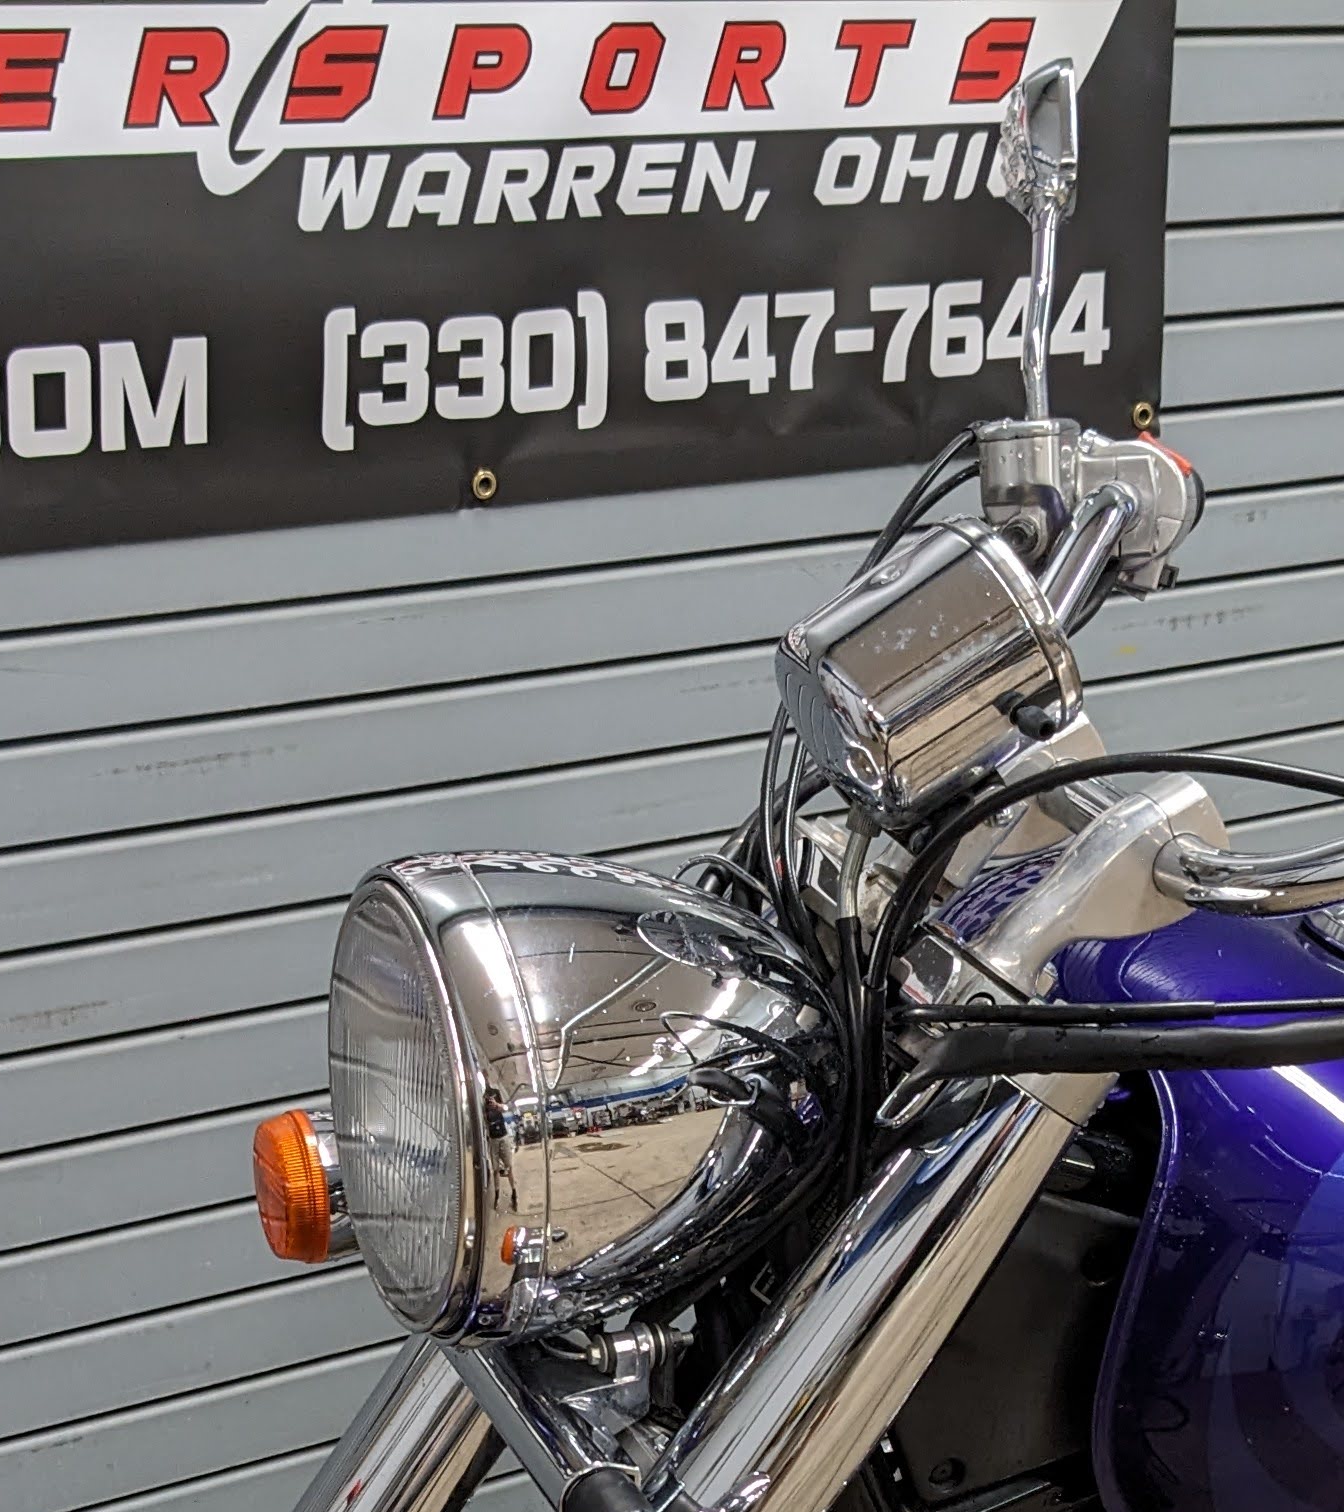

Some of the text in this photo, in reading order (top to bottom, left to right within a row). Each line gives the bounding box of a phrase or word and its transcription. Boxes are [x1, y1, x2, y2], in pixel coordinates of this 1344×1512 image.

[297, 140, 771, 232] WARREN,
[321, 289, 609, 452] (330)
[644, 270, 1111, 403] 847-7644
